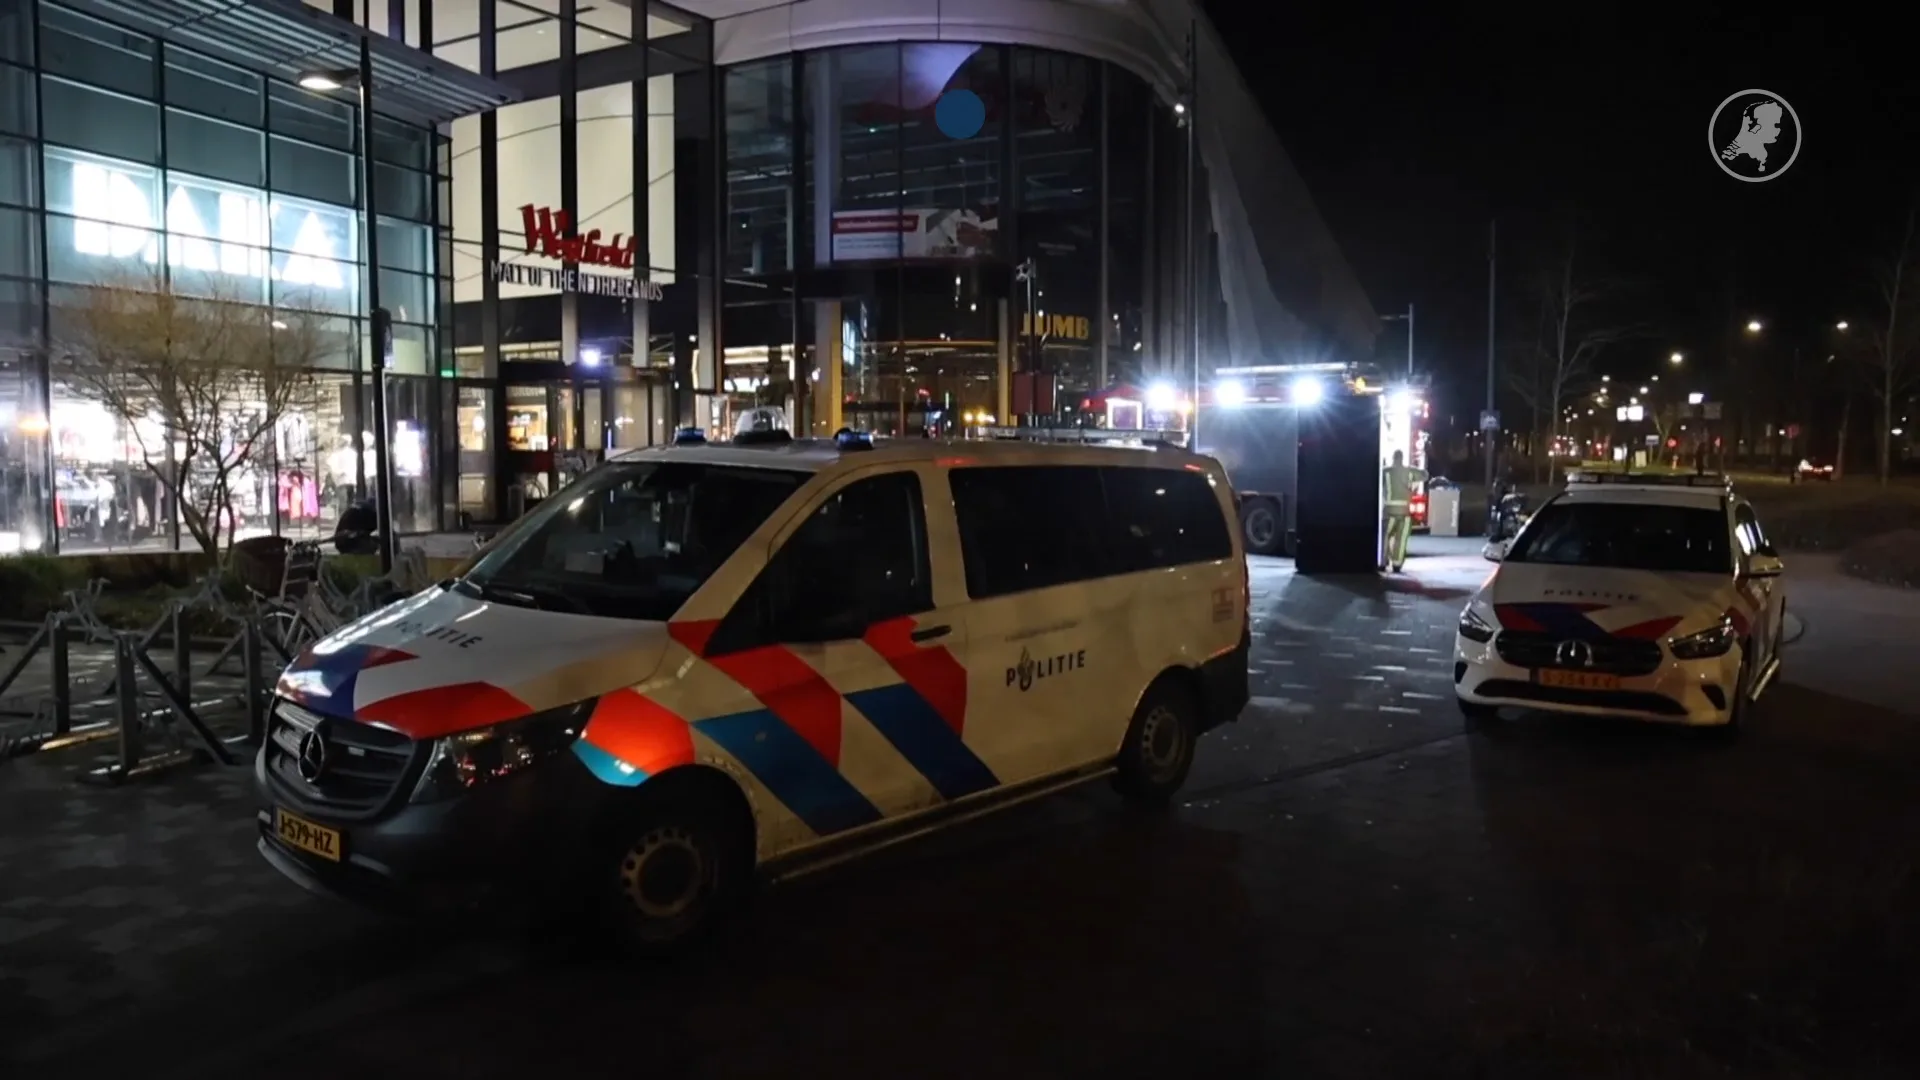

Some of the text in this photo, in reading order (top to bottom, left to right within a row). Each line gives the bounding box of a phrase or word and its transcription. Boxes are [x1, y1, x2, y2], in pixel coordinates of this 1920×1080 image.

[517, 203, 639, 270] Westfield
[490, 259, 527, 285] MALL
[528, 263, 545, 287] OF
[549, 267, 576, 291] THE
[1006, 649, 1086, 692] POLITIE
